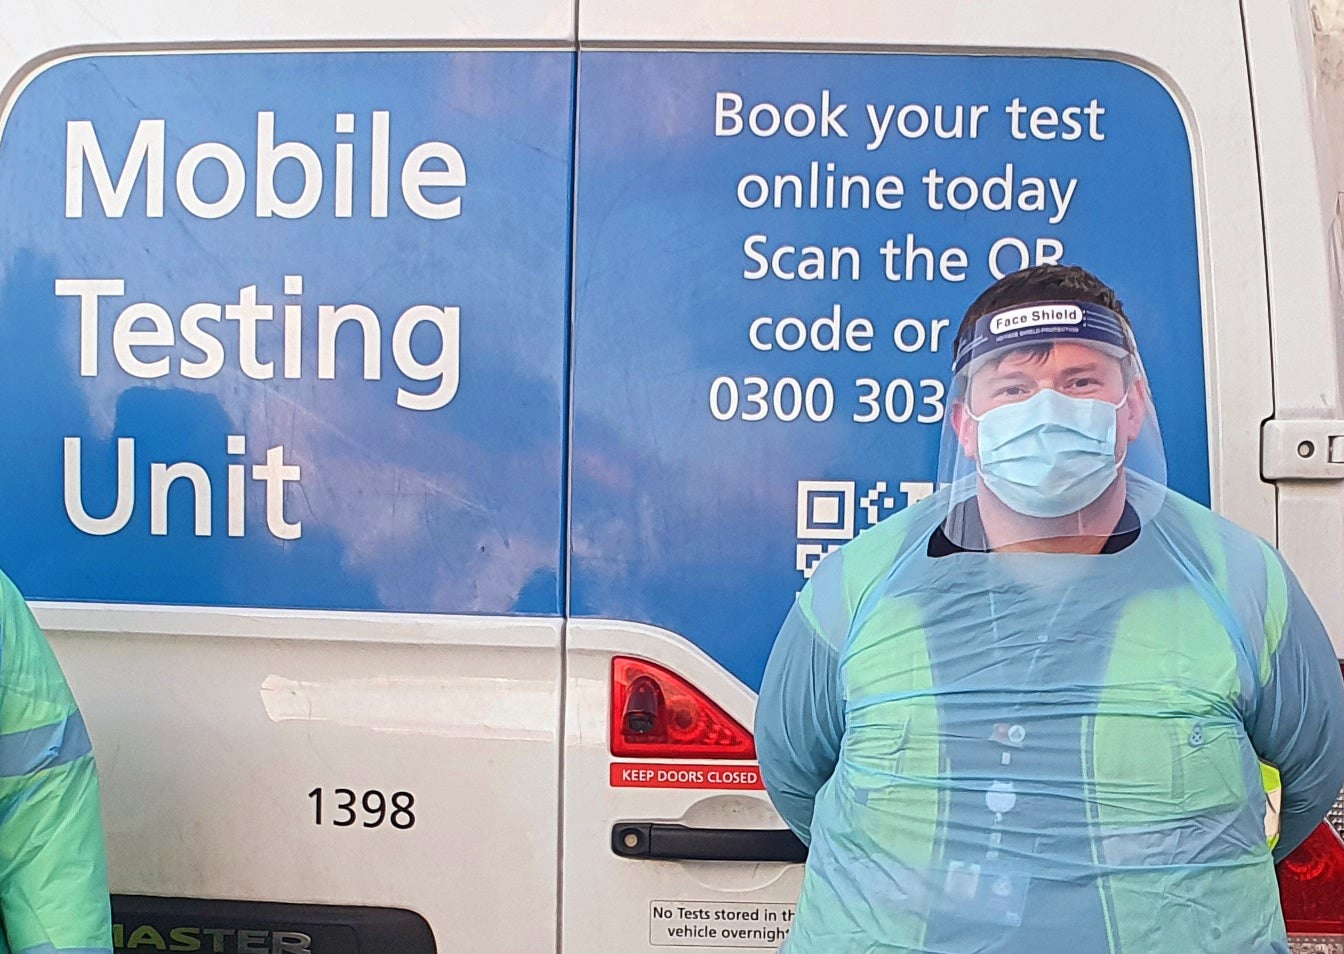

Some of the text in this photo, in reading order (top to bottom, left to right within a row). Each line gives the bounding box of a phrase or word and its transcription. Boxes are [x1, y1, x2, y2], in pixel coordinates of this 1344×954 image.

[714, 90, 1106, 150] Book your test
[65, 110, 467, 220] Mobile
[737, 161, 1078, 224] online today
[743, 234, 859, 281] Scan
[879, 233, 968, 281] the
[749, 304, 874, 351] code
[893, 318, 950, 353] or
[996, 309, 1077, 329] Face Shield
[55, 276, 461, 411] Testing
[709, 376, 945, 424] 0300 303
[62, 436, 303, 540] Unit
[622, 769, 757, 784] KEEP DOORS CLOSED
[308, 788, 415, 829] 1398
[653, 907, 795, 921] No Tests stored in th
[668, 925, 717, 938] vehicle
